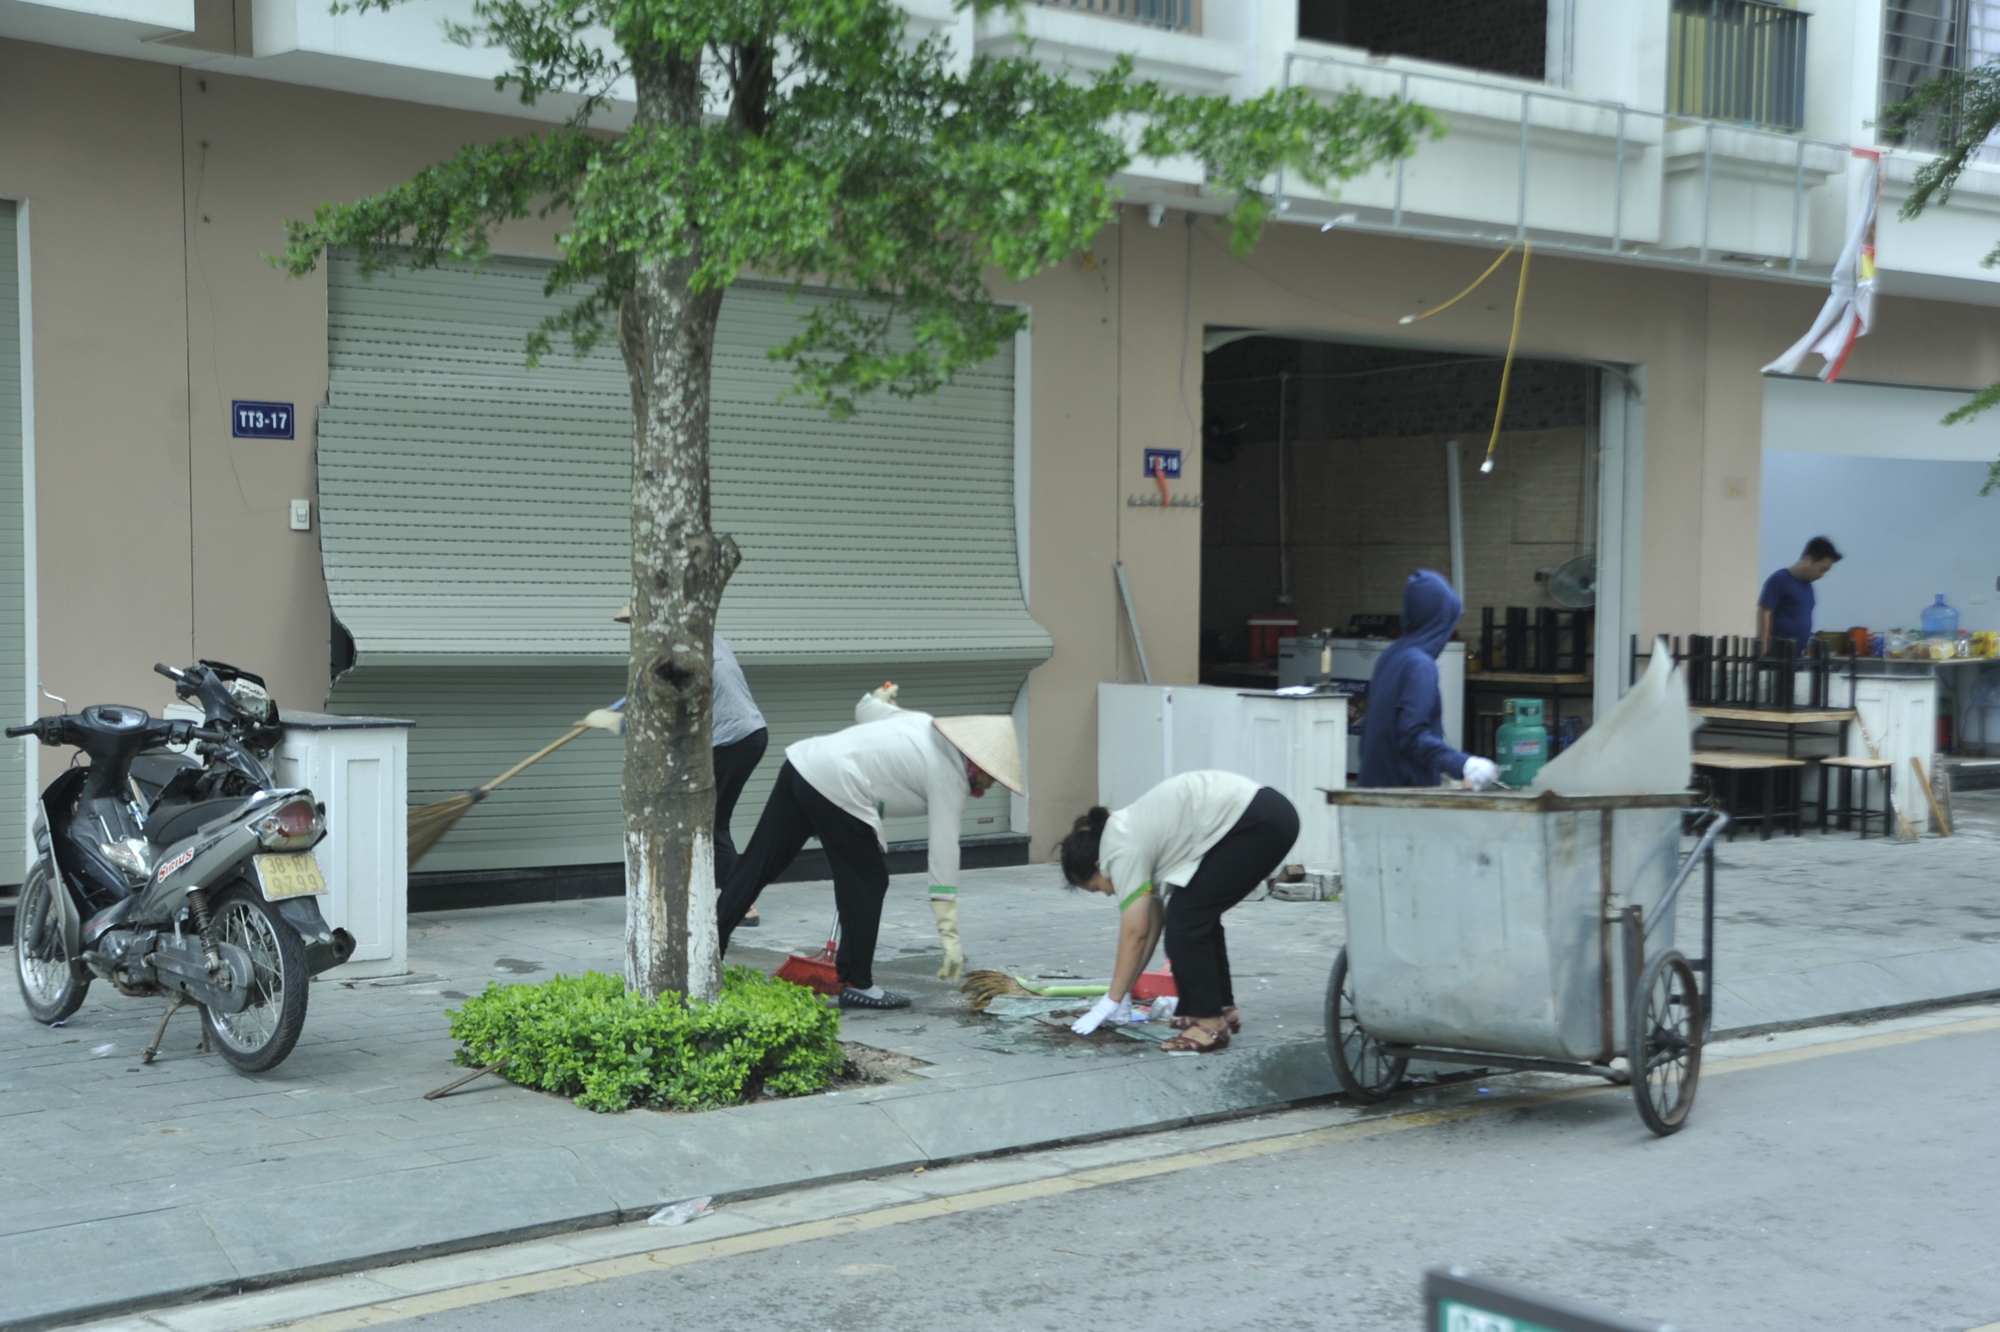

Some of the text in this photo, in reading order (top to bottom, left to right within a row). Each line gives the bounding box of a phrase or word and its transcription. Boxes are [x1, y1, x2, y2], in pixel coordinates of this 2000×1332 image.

[239, 411, 287, 429] TT3-17
[158, 848, 194, 882] SIRIUS
[272, 874, 319, 894] 9799
